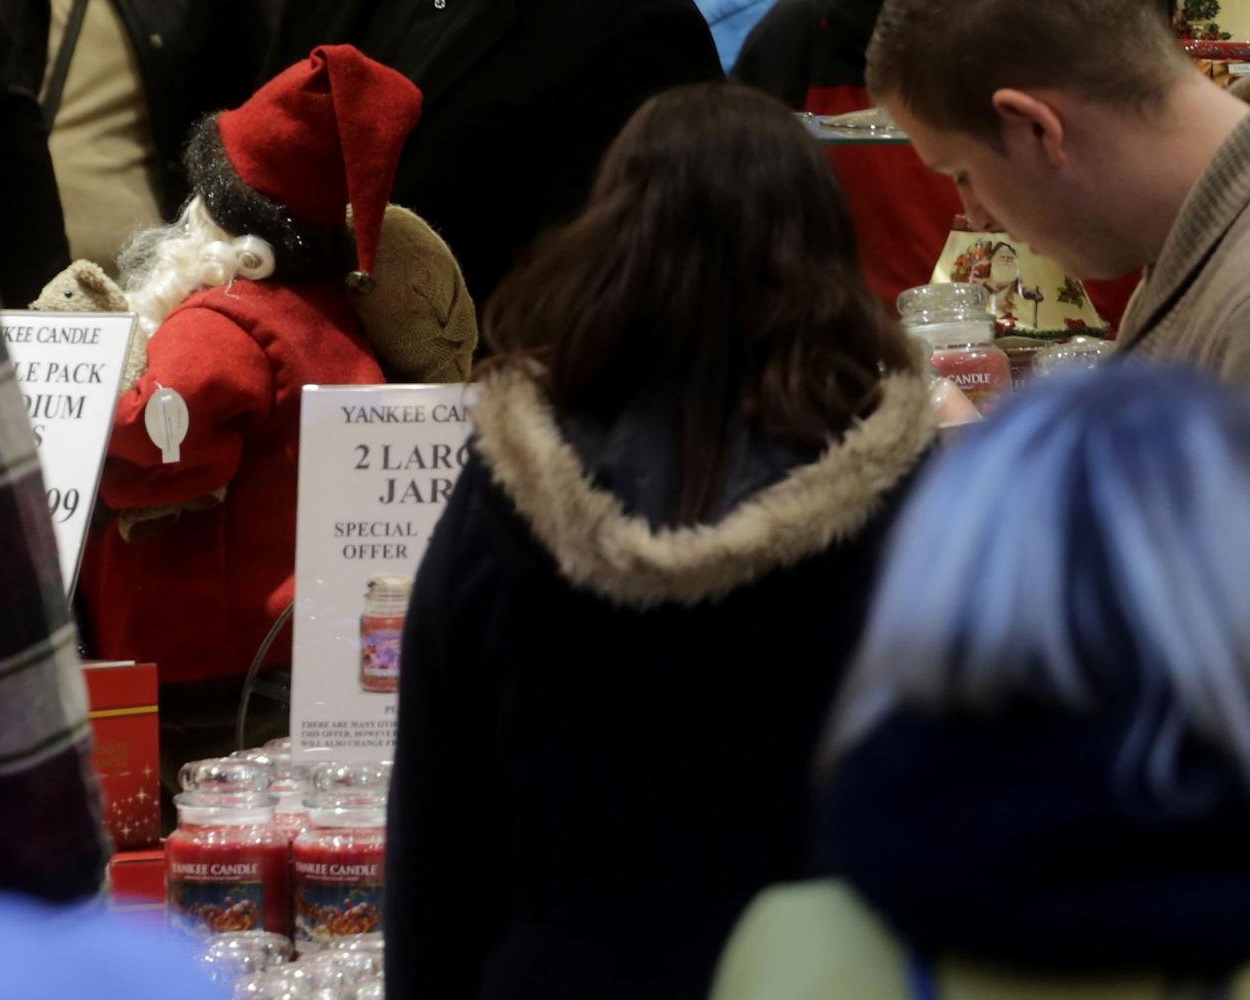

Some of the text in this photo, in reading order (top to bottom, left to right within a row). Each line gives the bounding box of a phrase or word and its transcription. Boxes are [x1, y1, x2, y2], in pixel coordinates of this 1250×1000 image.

[2, 327, 102, 345] KEE CANDLE
[13, 362, 106, 384] LE PACK
[341, 406, 426, 423] YANKEE
[354, 444, 370, 470] 2
[334, 521, 418, 538] SPECIAL
[342, 544, 408, 560] OFFER
[210, 863, 260, 876] CANDLE
[330, 864, 379, 877] CANDLE
